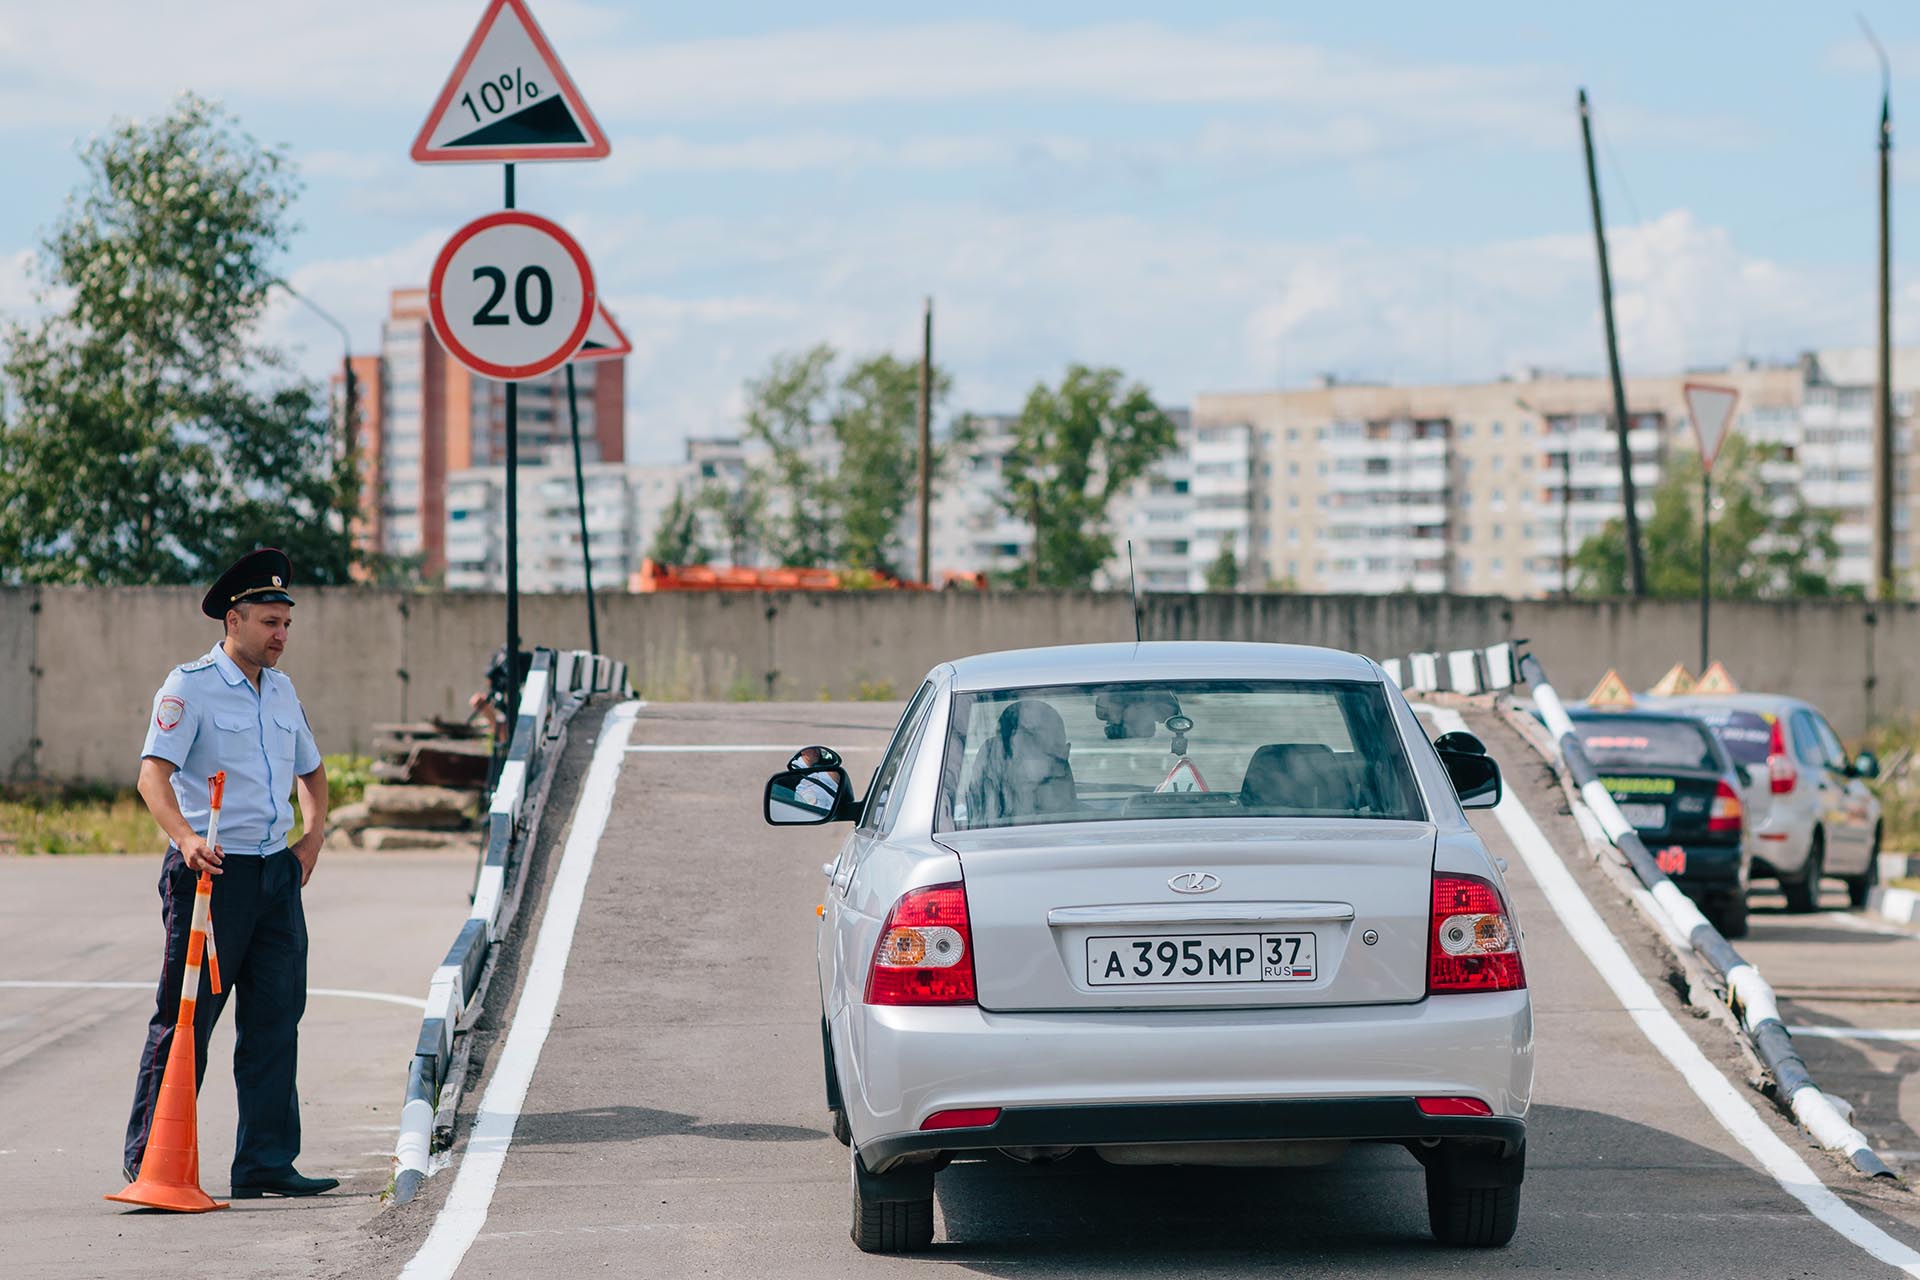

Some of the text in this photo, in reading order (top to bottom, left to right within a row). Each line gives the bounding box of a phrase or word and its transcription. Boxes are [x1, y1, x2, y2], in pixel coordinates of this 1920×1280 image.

[461, 67, 539, 122] 10%
[472, 265, 553, 326] 20
[1264, 966, 1292, 977] RUS
[1266, 938, 1302, 965] 37
